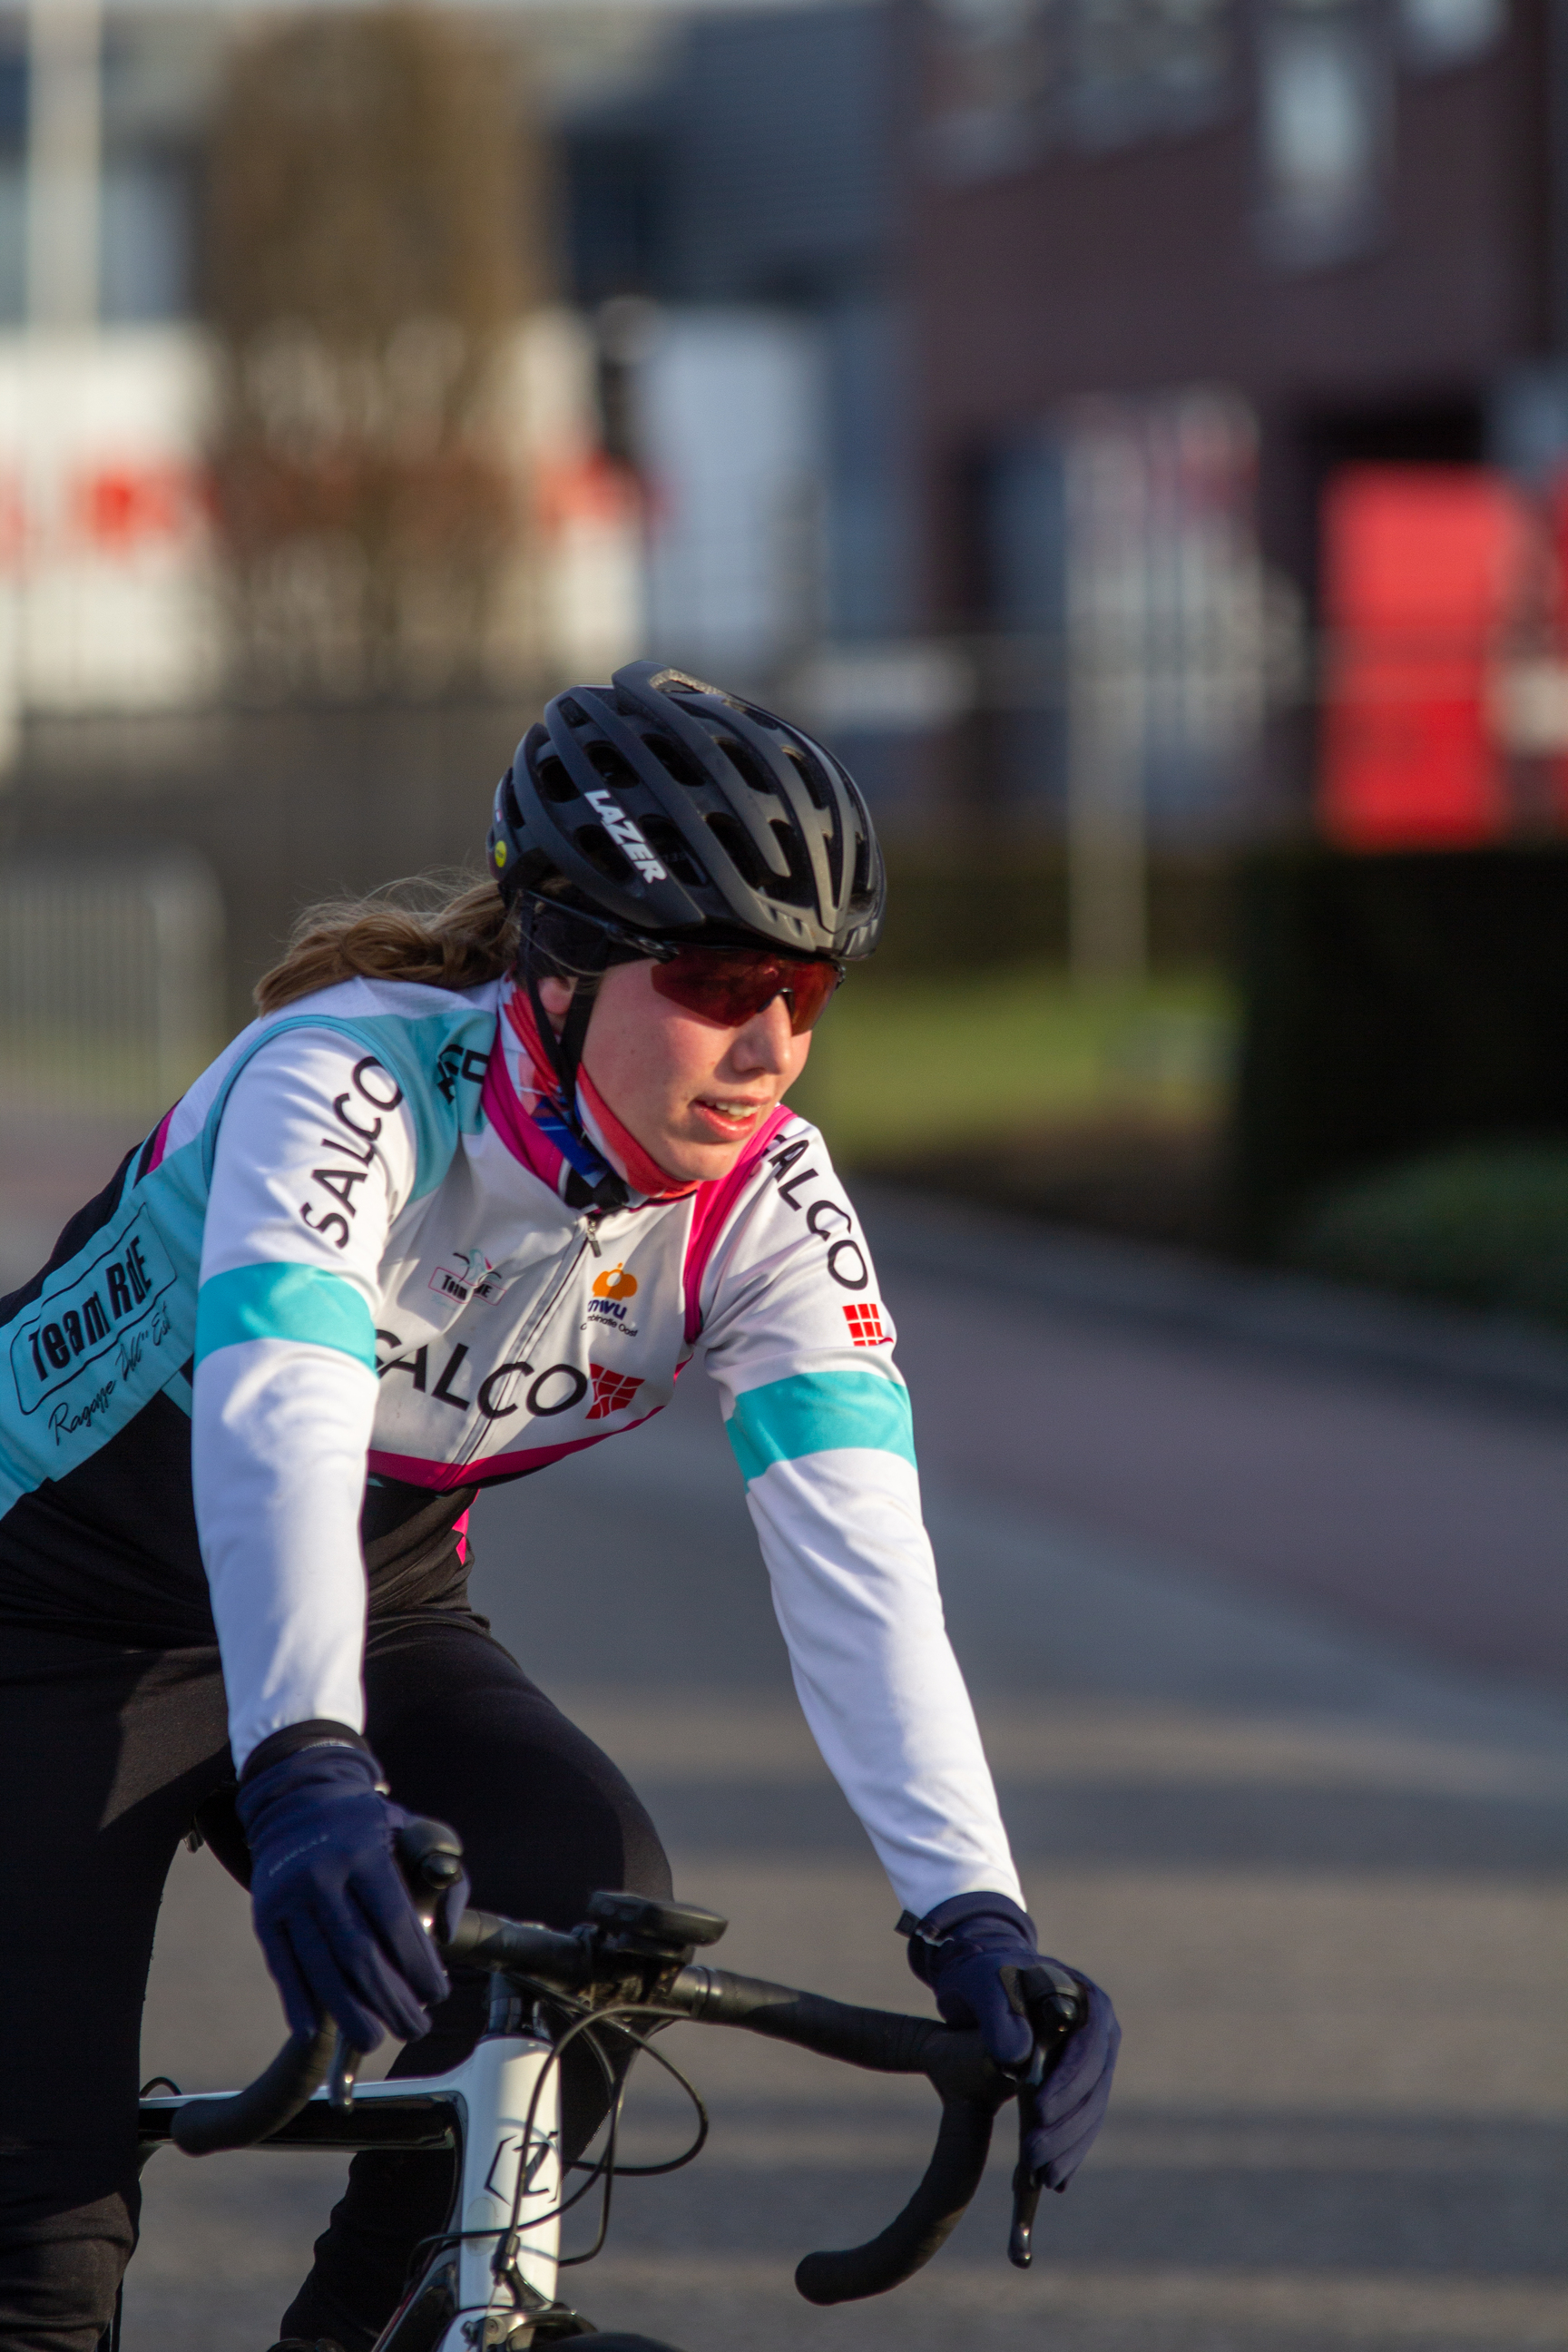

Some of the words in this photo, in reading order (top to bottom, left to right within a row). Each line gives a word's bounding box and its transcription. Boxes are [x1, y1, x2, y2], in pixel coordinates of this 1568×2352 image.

[584, 789, 668, 884] LAZER
[299, 1055, 403, 1250] SALCO
[28, 1290, 111, 1382] Team
